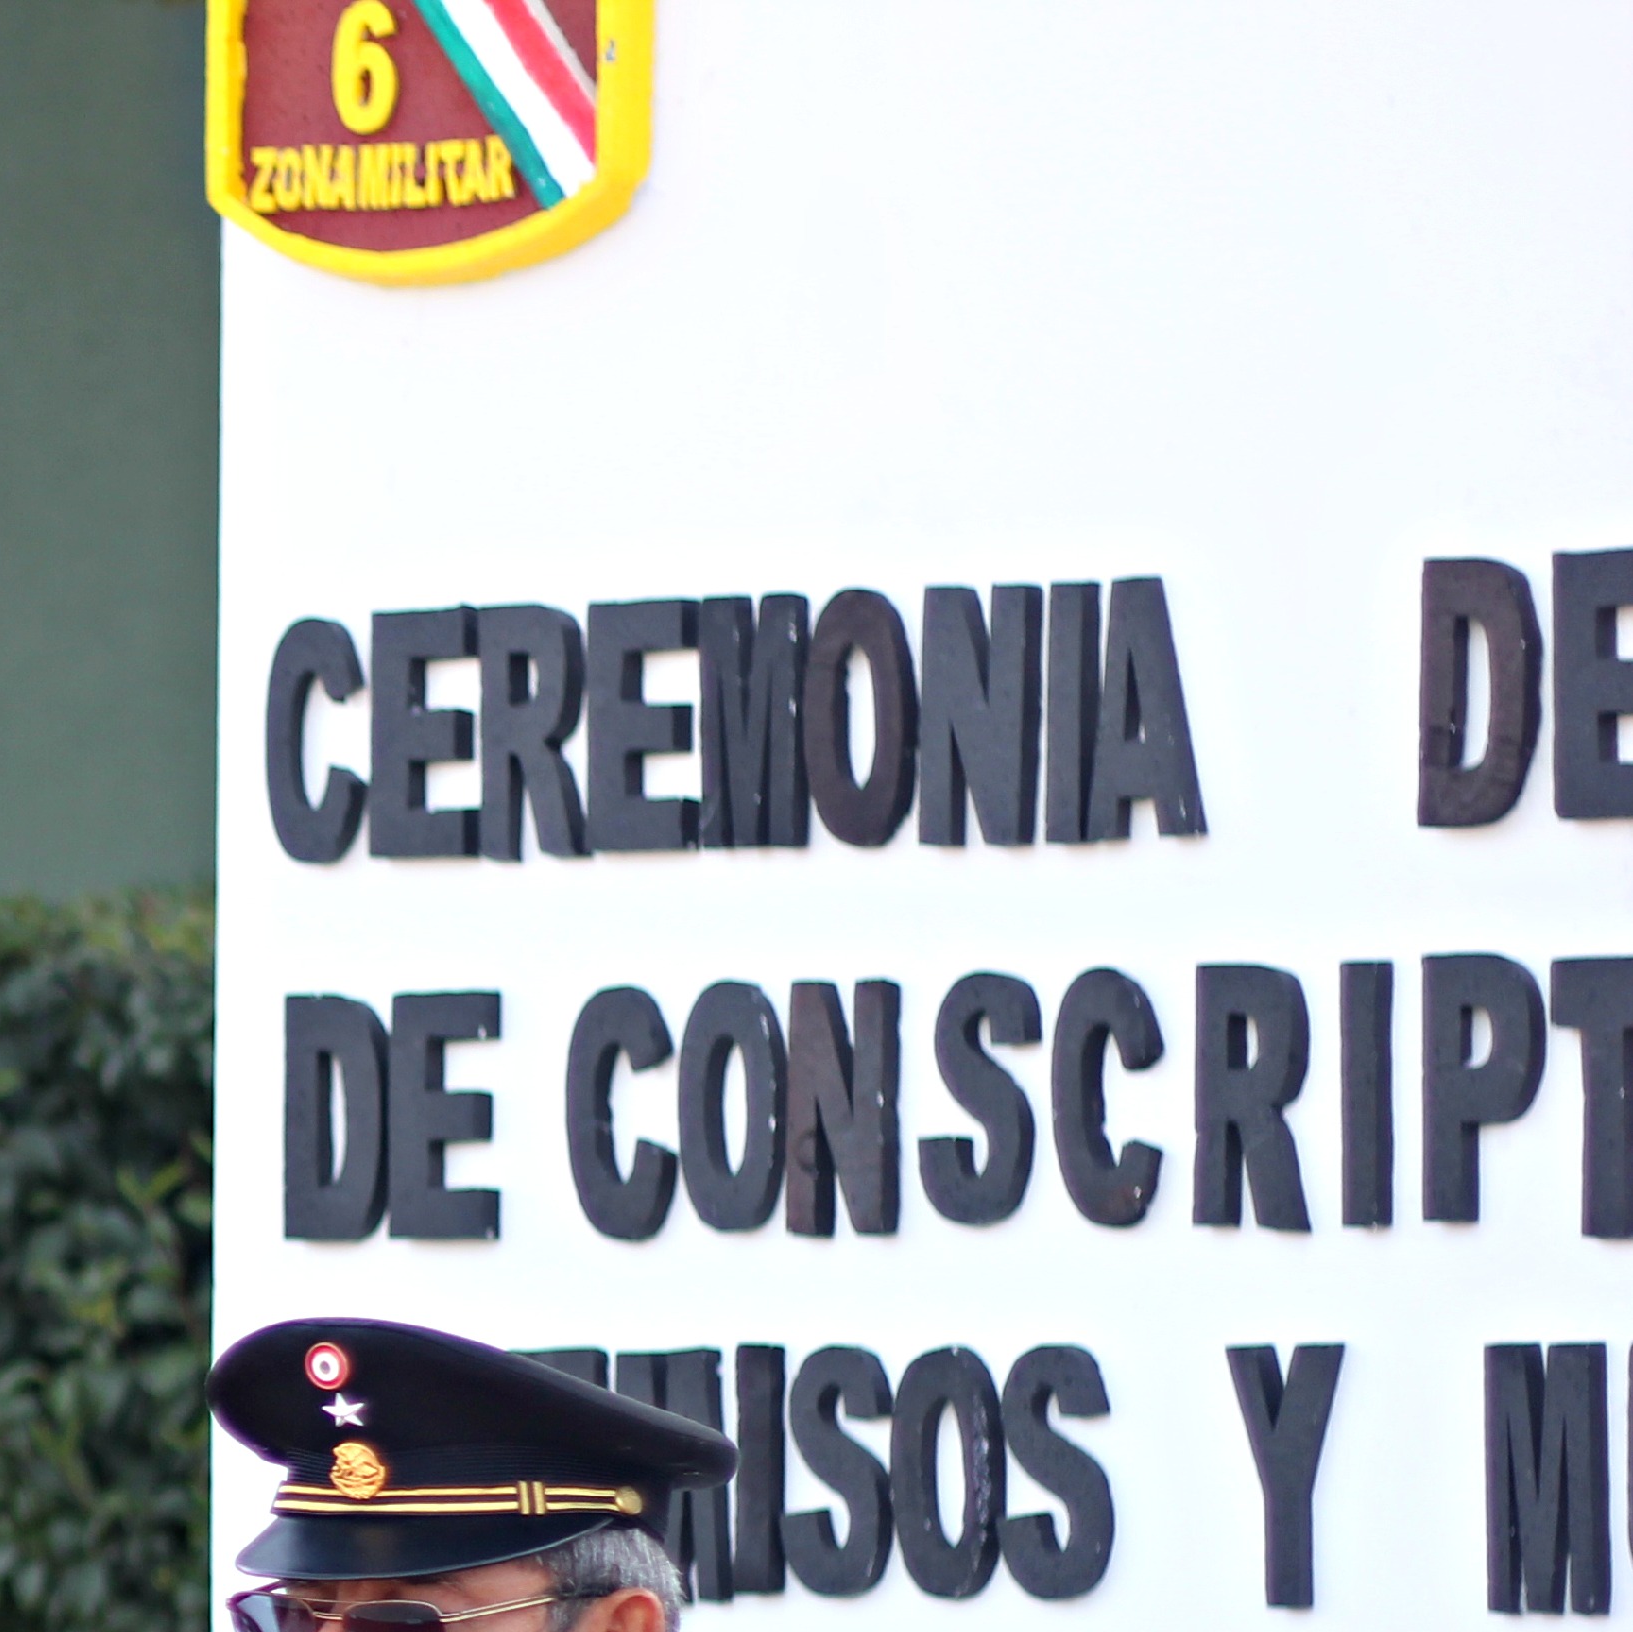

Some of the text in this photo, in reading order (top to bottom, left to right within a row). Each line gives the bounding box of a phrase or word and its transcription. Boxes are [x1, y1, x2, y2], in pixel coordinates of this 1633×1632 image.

[332, 0, 400, 135] 6
[265, 577, 1208, 864] CEREMONIA
[284, 991, 502, 1243] DE
[1225, 1344, 1345, 1610] Y
